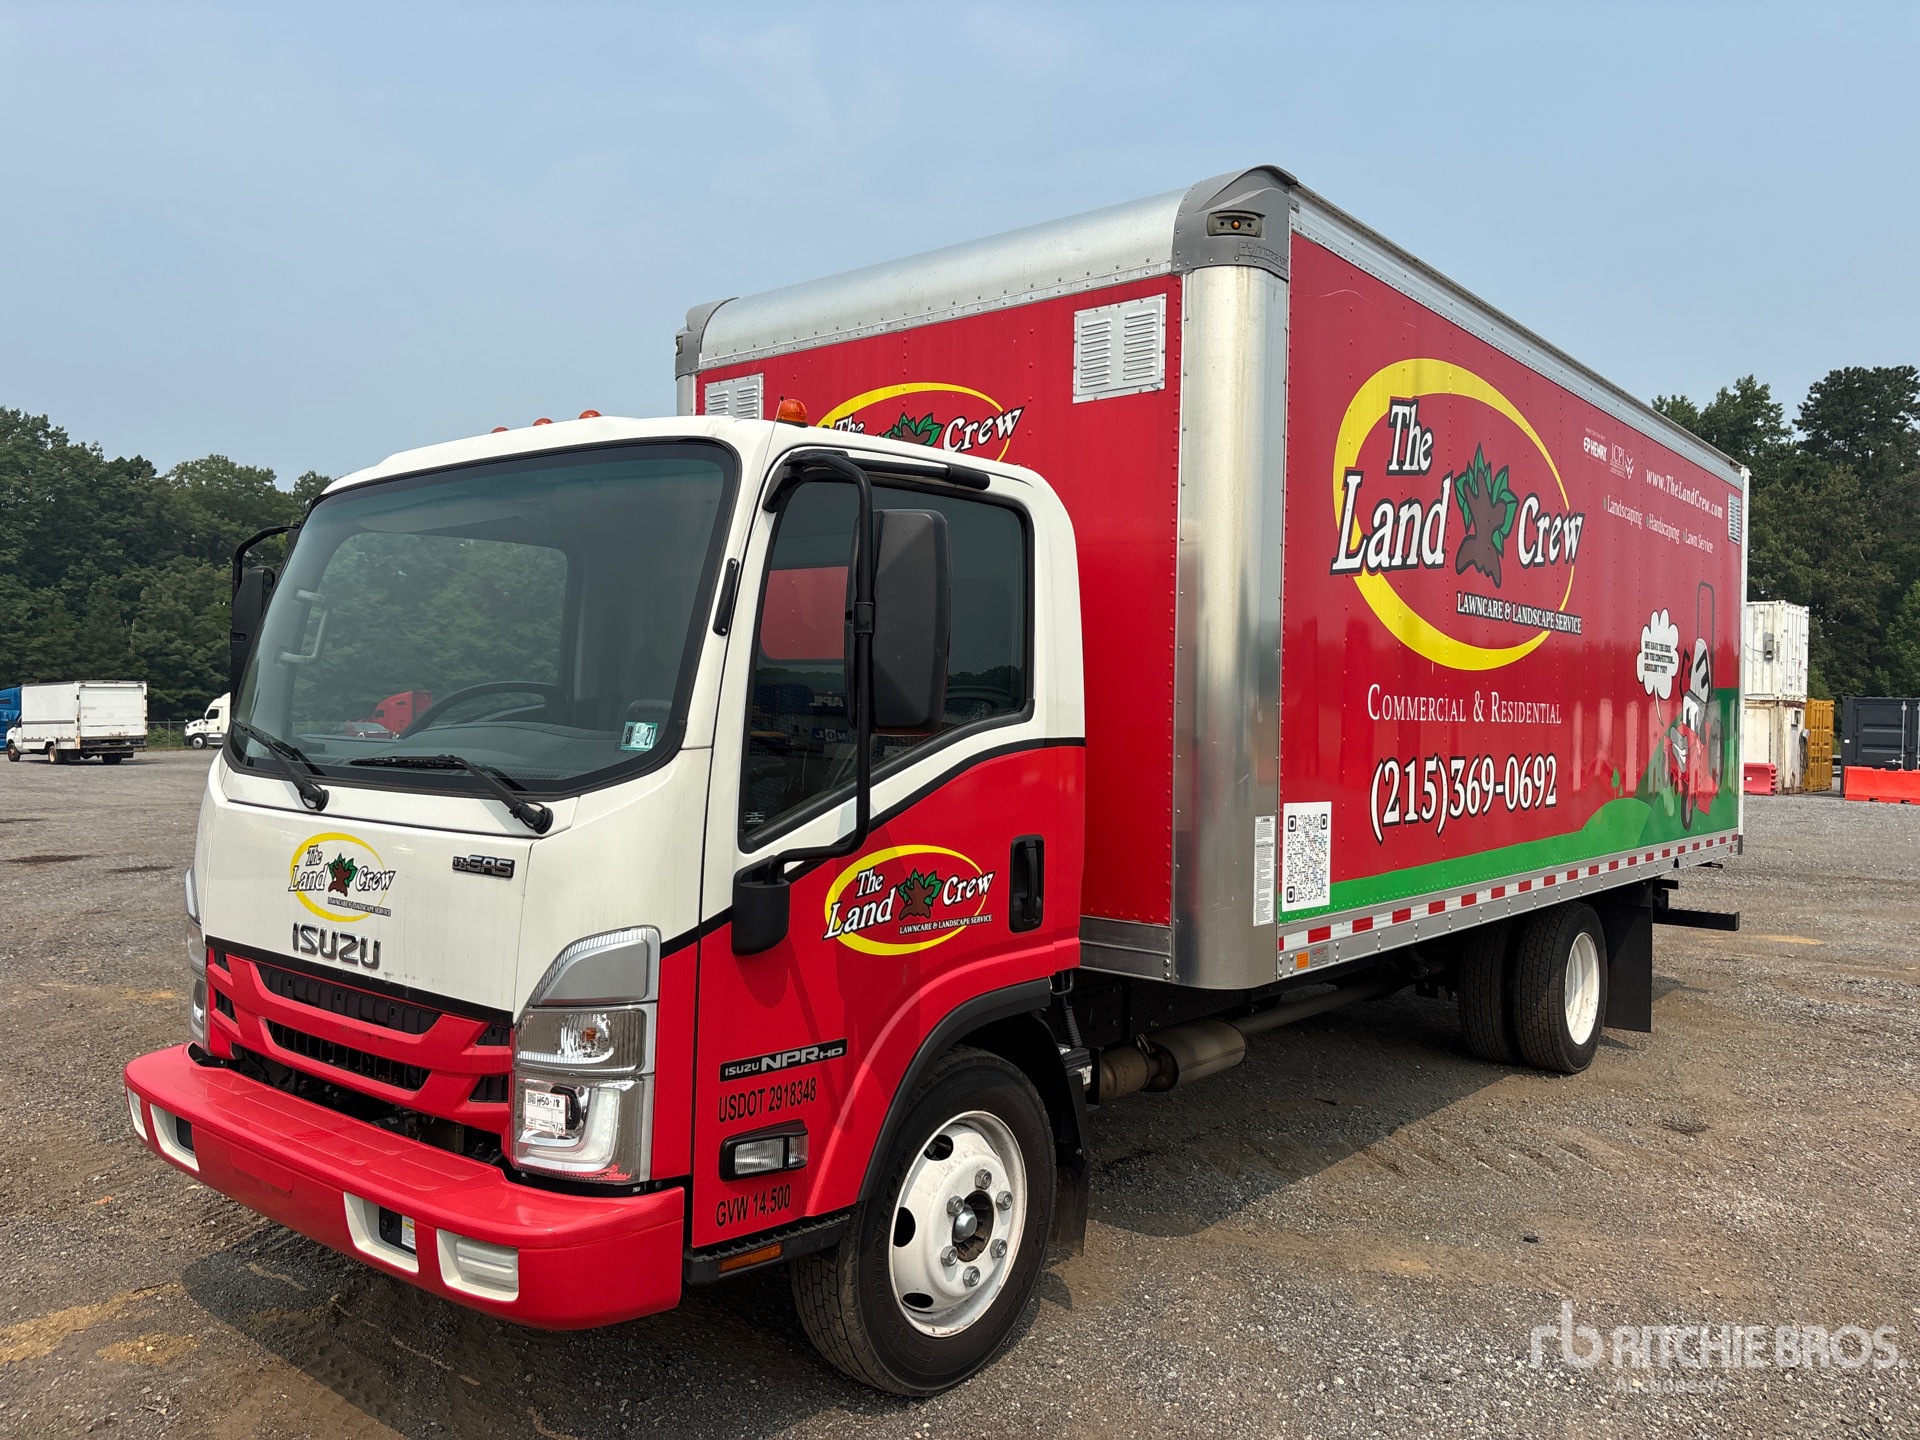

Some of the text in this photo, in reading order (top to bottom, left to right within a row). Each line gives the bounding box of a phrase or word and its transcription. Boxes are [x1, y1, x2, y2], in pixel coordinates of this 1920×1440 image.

[943, 406, 1025, 452] Crew
[1386, 400, 1434, 476] The
[1611, 443, 1625, 466] ICPI
[1607, 495, 1643, 529] Landscaping
[1646, 469, 1723, 519] www.TheLandCrew.com
[1330, 471, 1585, 574] Land Crew
[1649, 513, 1680, 545] Hardscaping
[1685, 529, 1713, 554] Lawn Service
[1456, 592, 1582, 634] LAWNCARE & LANDSCAPE SERVICE
[1473, 690, 1485, 722] &
[1370, 752, 1557, 846] (215)369-0692
[306, 845, 323, 866] The
[288, 862, 396, 892] Land Crew
[856, 867, 884, 898] The
[823, 872, 995, 940] Land Crew
[900, 914, 993, 935] LAWNCARE & LANDSCAPE SERVICE
[293, 922, 382, 970] ISUZU
[725, 1046, 843, 1077] ISUZU NPR HD
[719, 1077, 817, 1123] USDOT 2918348
[716, 1184, 791, 1228] GVW 14,500
